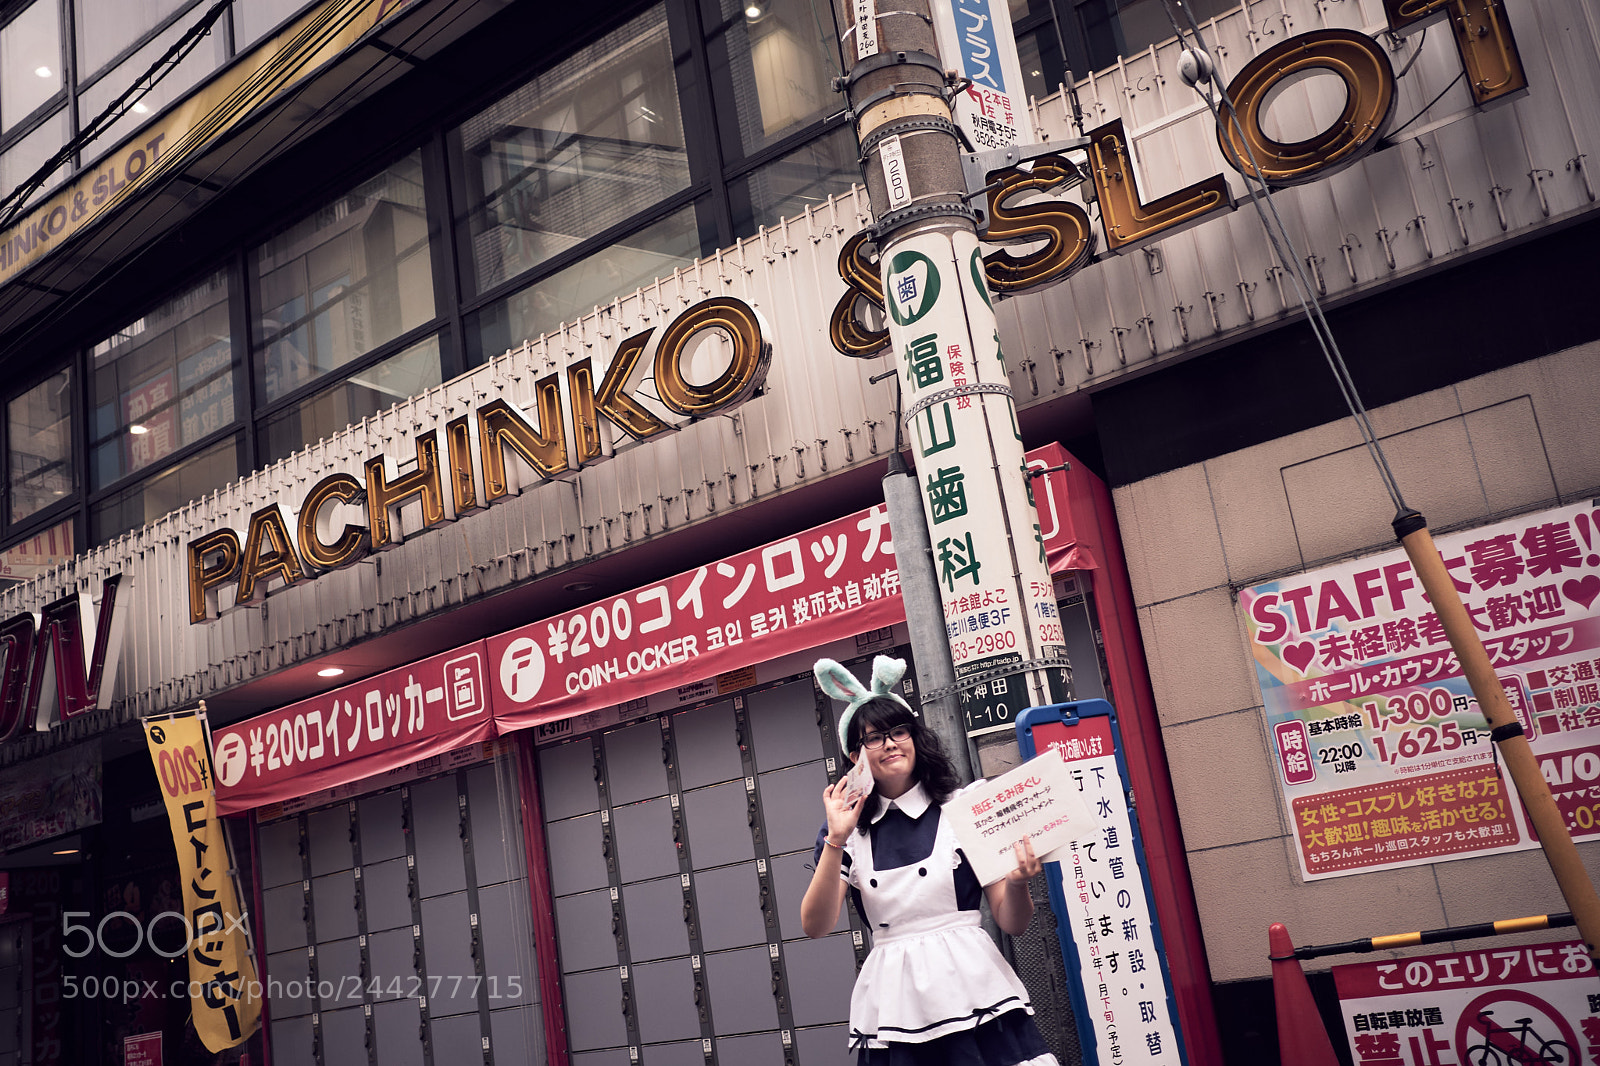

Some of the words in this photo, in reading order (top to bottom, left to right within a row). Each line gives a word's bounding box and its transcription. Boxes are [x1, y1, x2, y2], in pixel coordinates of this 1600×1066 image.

[92, 132, 165, 206] SLOT
[888, 159, 905, 200] 260
[897, 275, 917, 304] 歯
[187, 296, 766, 625] PACHINKO
[904, 333, 981, 593] 福山歯科
[565, 635, 699, 694] COIN-LOCKER
[707, 619, 744, 651] 코인
[750, 605, 788, 639] 로커
[1309, 627, 1574, 703] ホール・カウンタスタッフ
[1548, 657, 1600, 687] 交通
[250, 674, 444, 776] ¥200コインロッカー
[540, 719, 570, 738] K-3177
[966, 703, 1008, 726] 1-10
[1308, 714, 1362, 737] 基本時給
[1281, 729, 1310, 775] 時給
[1318, 742, 1363, 765] 22:00
[1334, 760, 1357, 774] 以降
[971, 776, 1041, 817] 指圧・もみほぐし
[1300, 776, 1500, 827] 女性・コスプレ好きな方
[1376, 943, 1594, 990] このエリアにお
[1353, 1007, 1444, 1032] 自転車放置
